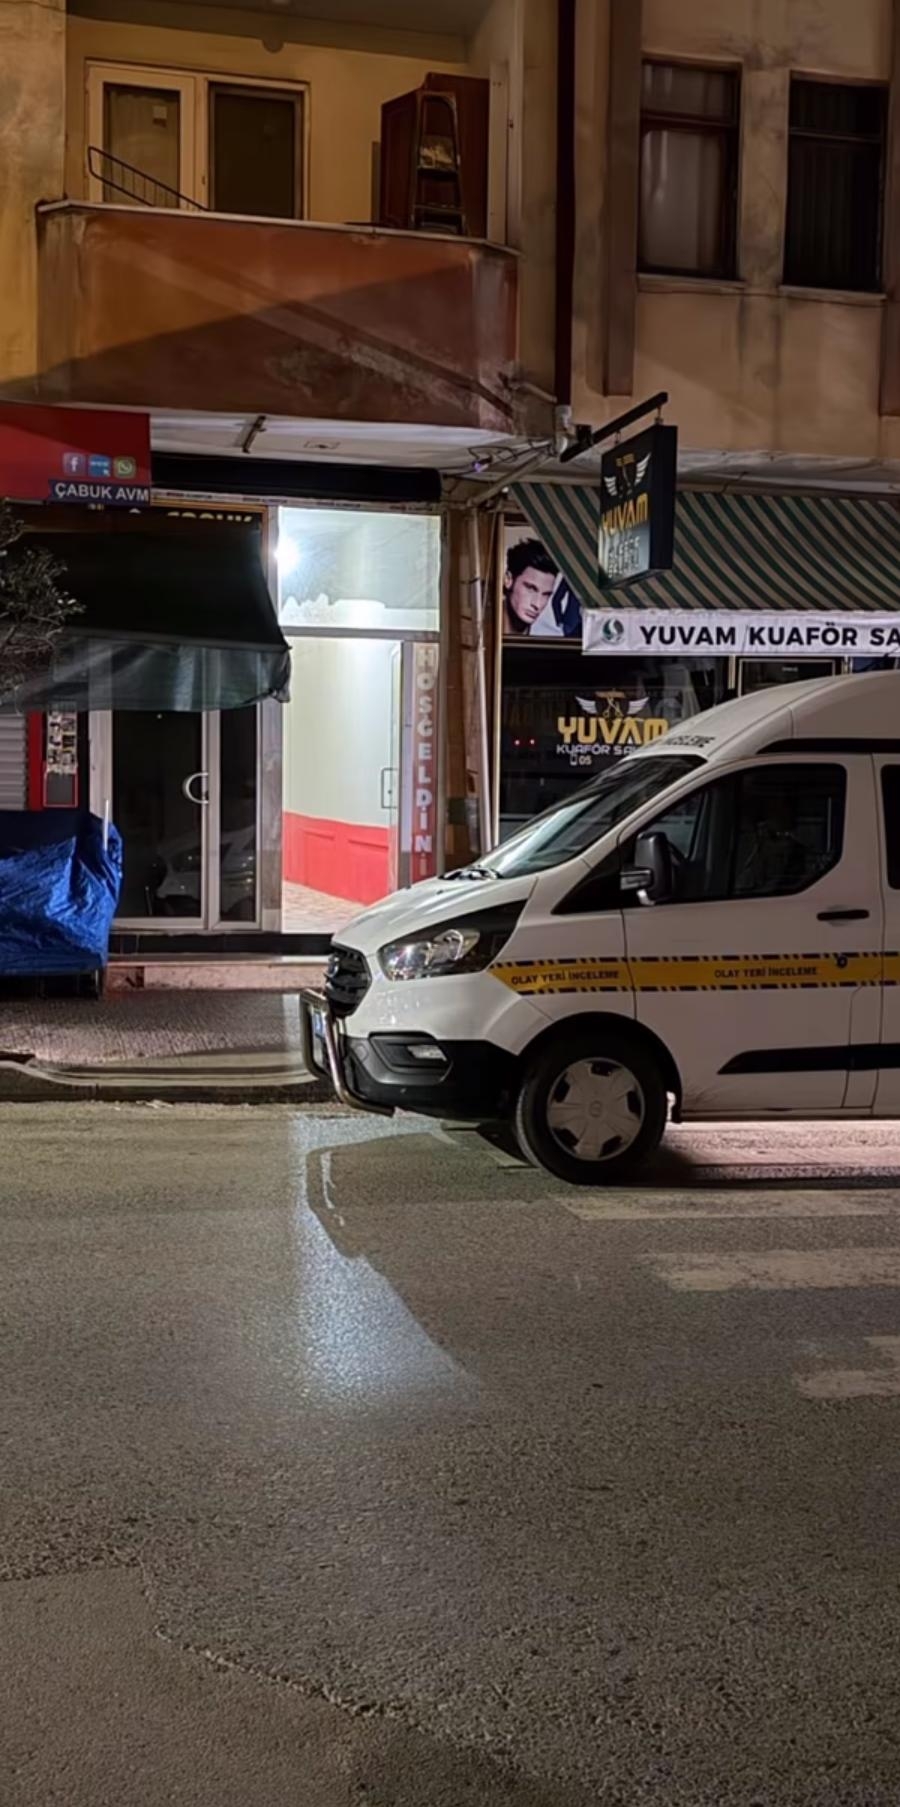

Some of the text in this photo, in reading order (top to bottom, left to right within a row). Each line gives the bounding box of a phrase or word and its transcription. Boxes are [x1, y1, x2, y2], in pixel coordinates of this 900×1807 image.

[55, 483, 112, 499] ÇABUK
[115, 487, 149, 501] AVM
[640, 626, 735, 646] YUVAM
[749, 622, 858, 647] KUAFÖR
[558, 717, 669, 745] YUVAM
[556, 743, 610, 755] KUAFÖR
[511, 970, 620, 985] OLAY YERİ İNCELEME
[714, 967, 817, 978] OLAY YERİ İNCELEME
